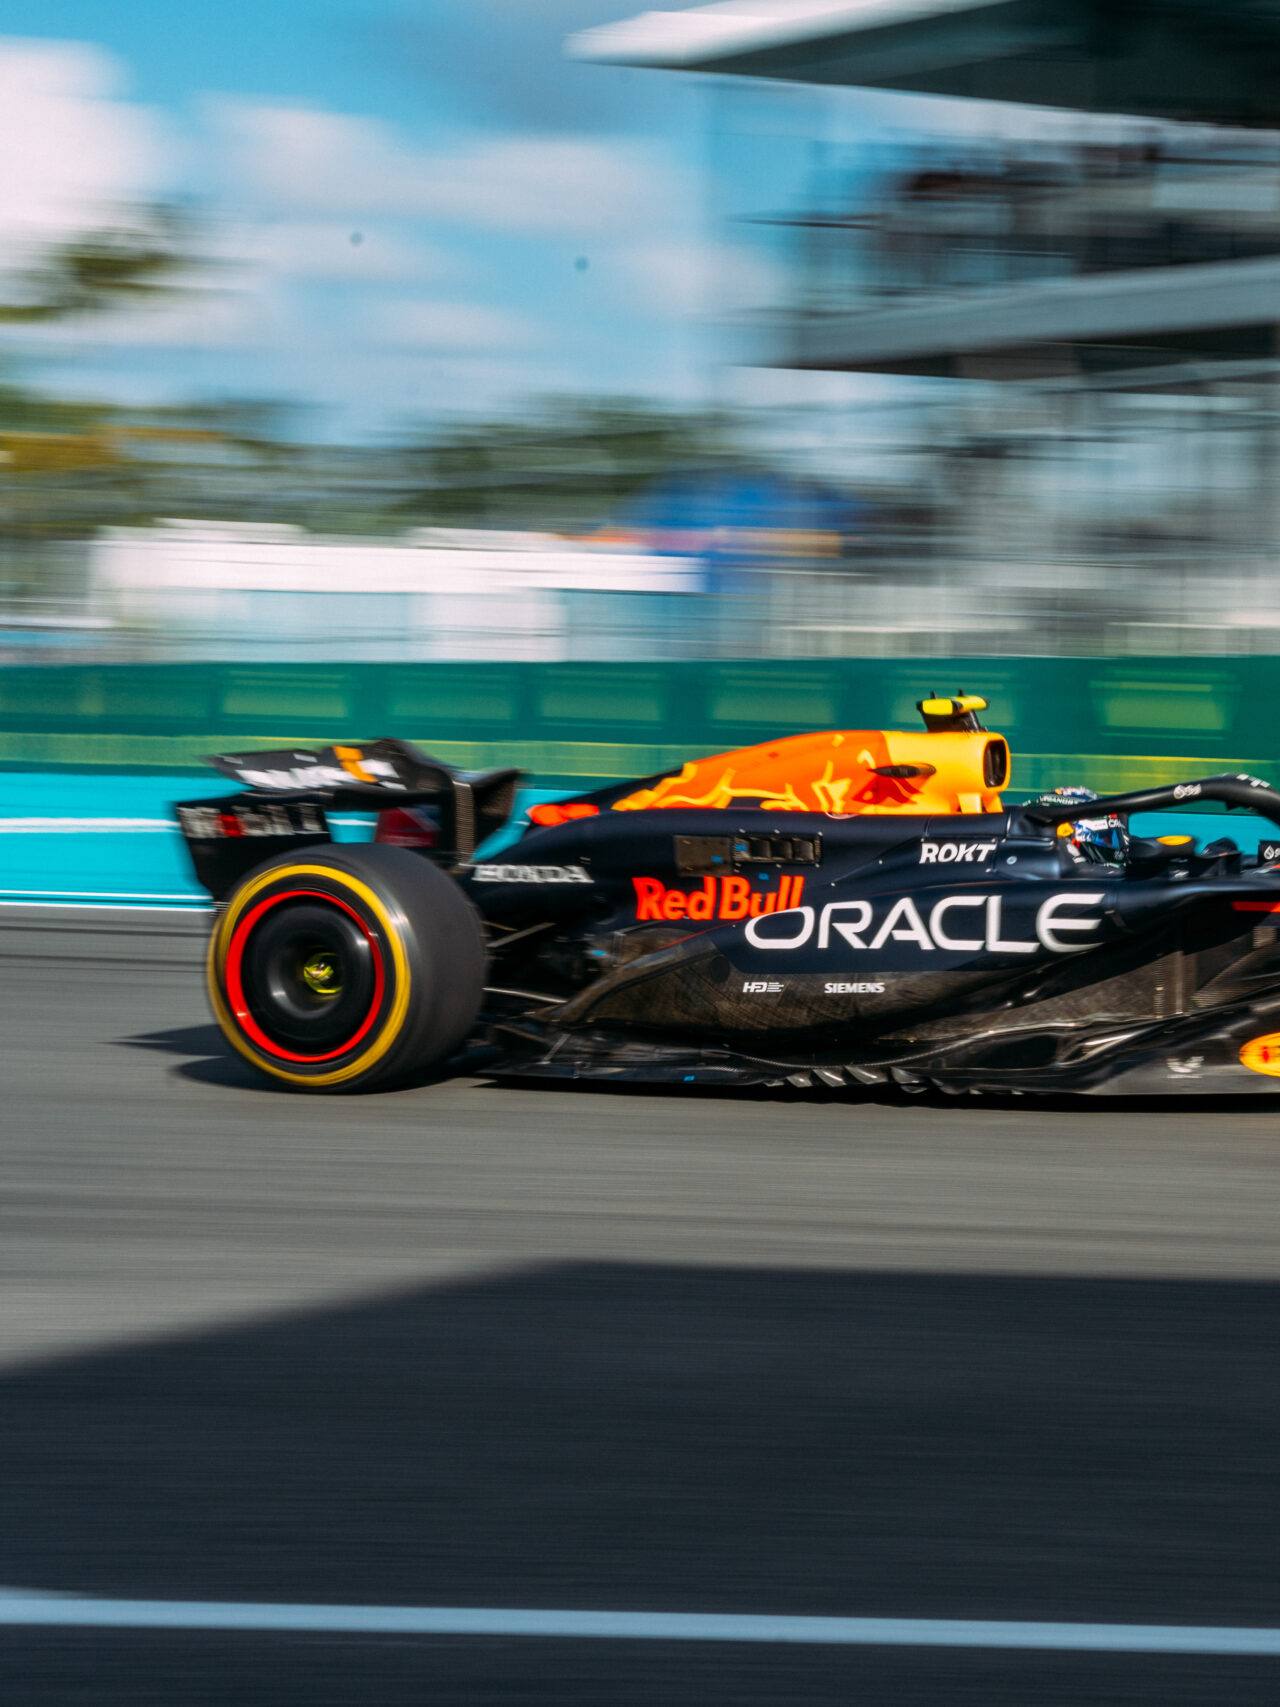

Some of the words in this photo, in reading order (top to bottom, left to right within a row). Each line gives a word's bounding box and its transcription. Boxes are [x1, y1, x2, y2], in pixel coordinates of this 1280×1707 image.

[919, 842, 997, 864] ROKT
[471, 864, 595, 883] HONDA
[744, 893, 1105, 953] ORACLE
[824, 982, 886, 994] SIEMENS
